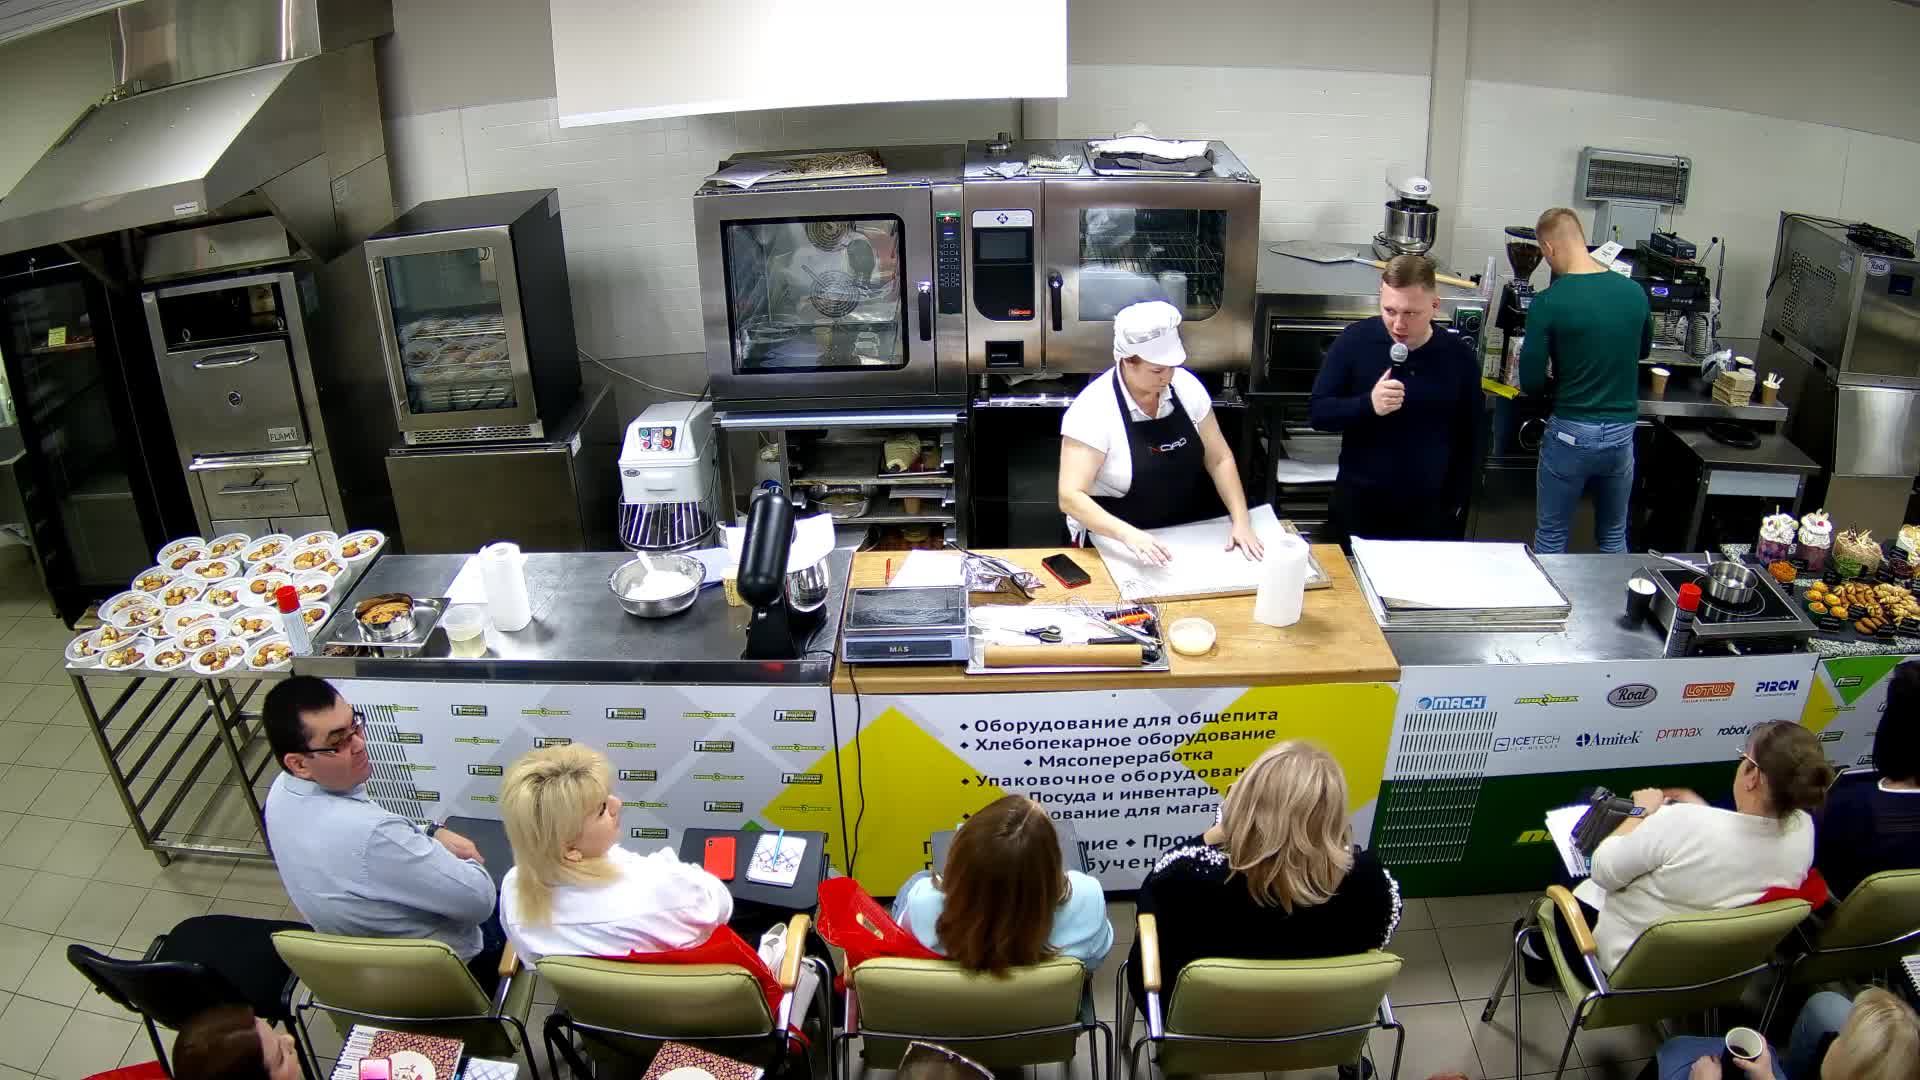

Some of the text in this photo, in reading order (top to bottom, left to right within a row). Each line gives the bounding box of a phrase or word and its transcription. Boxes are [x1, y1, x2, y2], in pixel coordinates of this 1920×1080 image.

[1618, 687, 1650, 701] Roal
[1686, 683, 1733, 697] LOTUS
[1433, 697, 1483, 710] MACH
[974, 710, 1279, 734] Оборудование для общепита
[975, 729, 1276, 751] Хлебопекарное оборудование
[1512, 736, 1560, 746] ICETECH
[1589, 731, 1640, 747] Amitek
[1656, 726, 1704, 742] primax
[1039, 750, 1213, 768] Мясопереработка
[976, 766, 1245, 787] Упаковочное оборудован
[1029, 791, 1096, 804] Посуда
[1102, 791, 1113, 801] и
[1120, 784, 1219, 800] инвентарь
[1050, 802, 1219, 820] ование для магаз
